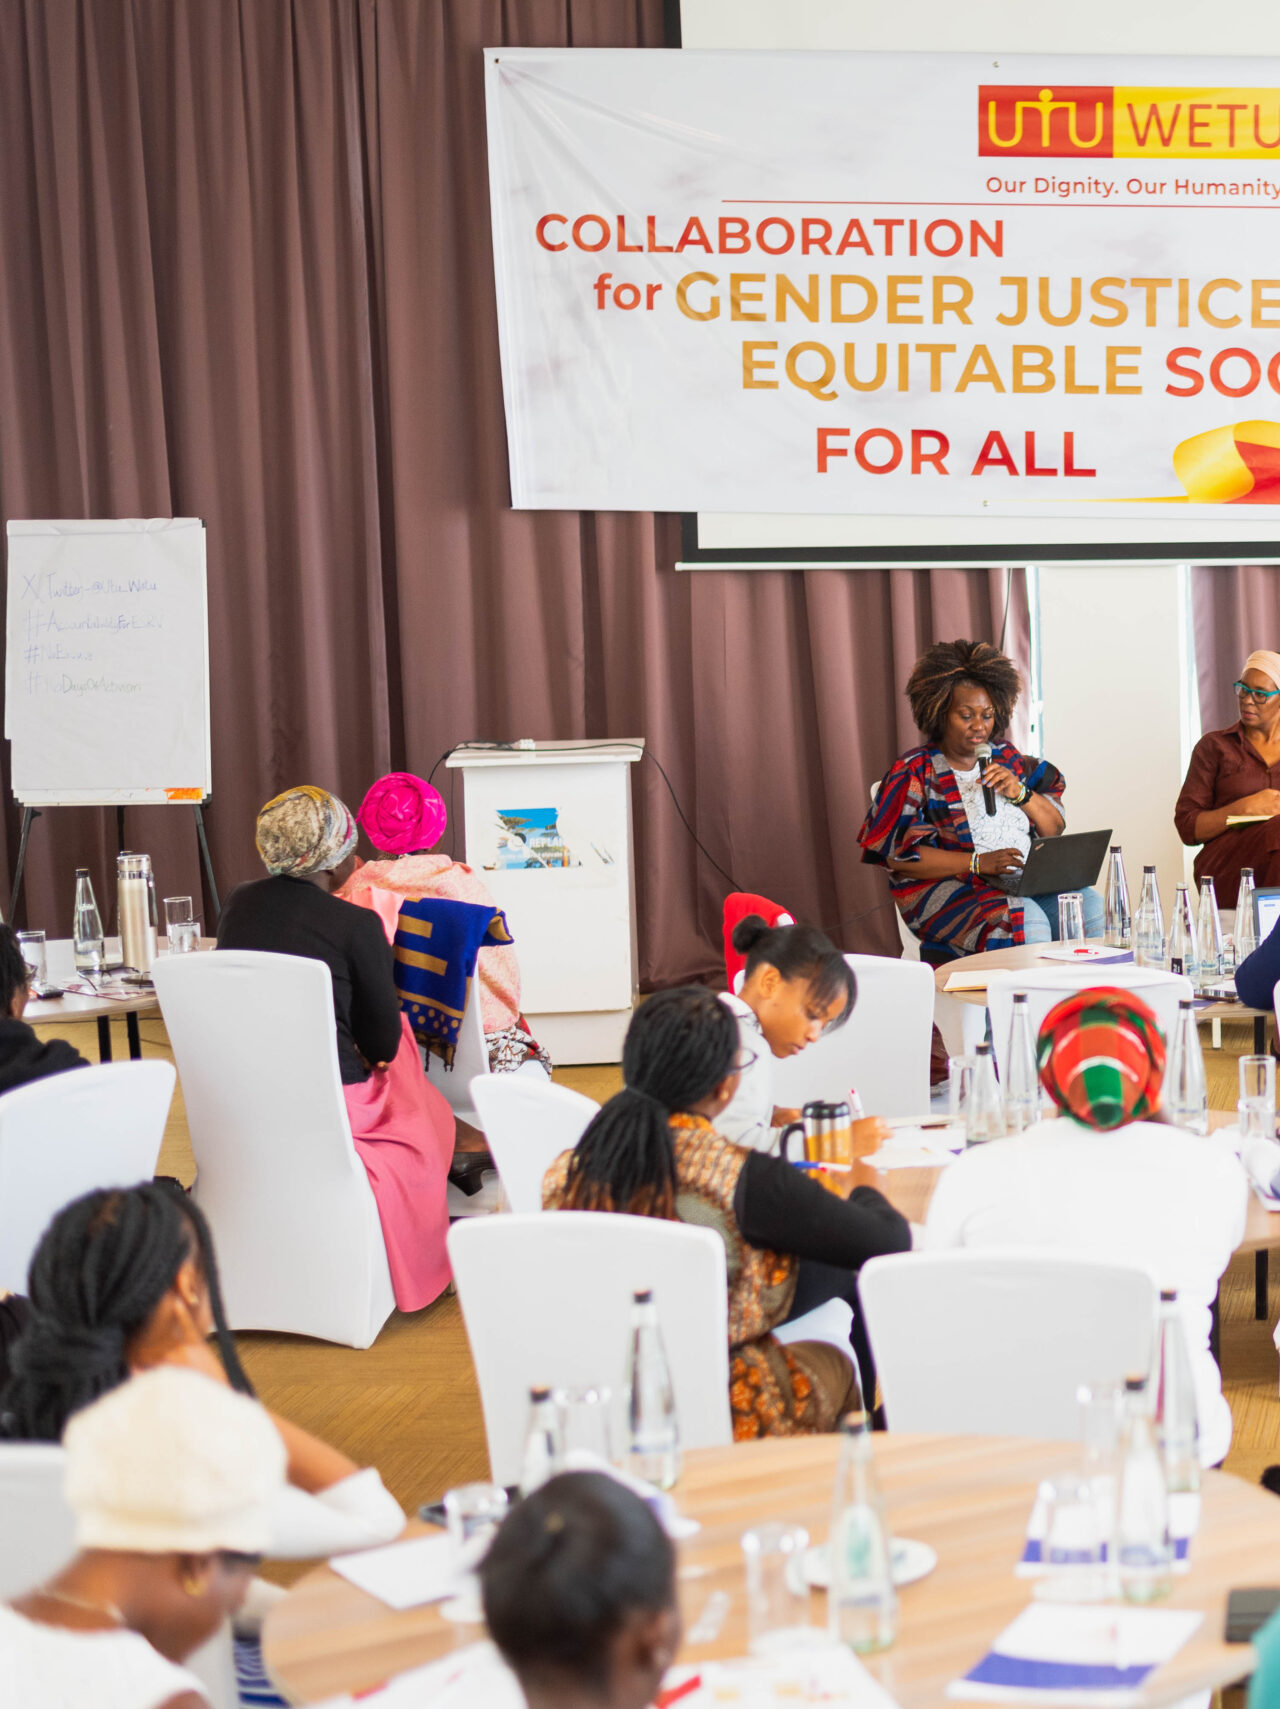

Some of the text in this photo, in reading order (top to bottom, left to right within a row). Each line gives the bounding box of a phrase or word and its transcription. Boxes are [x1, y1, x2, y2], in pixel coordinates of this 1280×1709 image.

[986, 176, 1027, 194] Our
[1034, 177, 1119, 199] Dignity.
[1126, 178, 1167, 195] Our
[536, 213, 1004, 258] COLLABORATION
[593, 272, 663, 311] for
[676, 270, 974, 326] GENDER
[741, 340, 1143, 402] EQUITABLE
[816, 426, 1097, 478] FOR ALL
